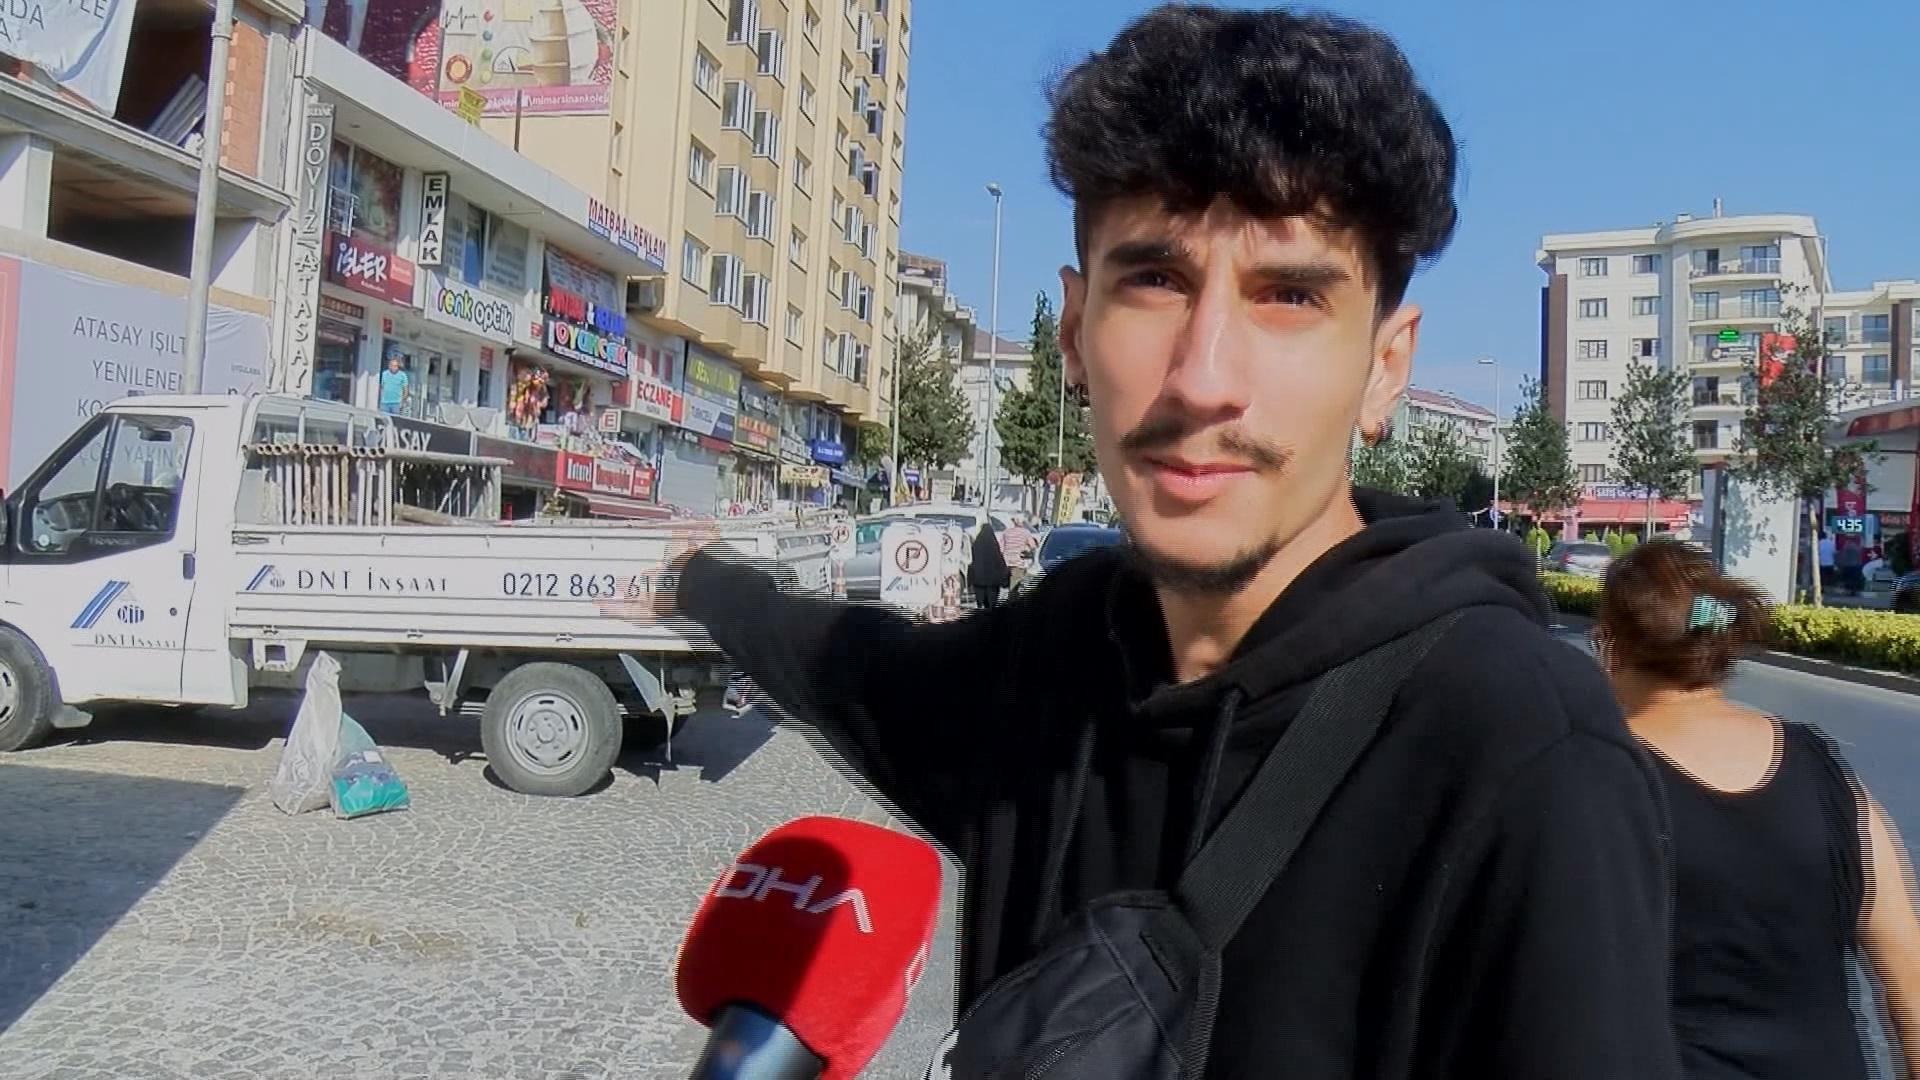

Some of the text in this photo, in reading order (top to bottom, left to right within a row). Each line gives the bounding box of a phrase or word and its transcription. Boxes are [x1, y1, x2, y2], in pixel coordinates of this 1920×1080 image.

[423, 178, 443, 261] EMLAK
[589, 198, 628, 240] MATBAA
[633, 224, 666, 260] REKLAM
[73, 317, 142, 346] ATASAY
[438, 288, 473, 322] renk
[474, 301, 512, 335] optik
[638, 380, 672, 408] ECZANE
[299, 569, 351, 590] DNT
[503, 572, 559, 597] 0212
[570, 573, 616, 599] 863
[715, 862, 876, 934] DHA
